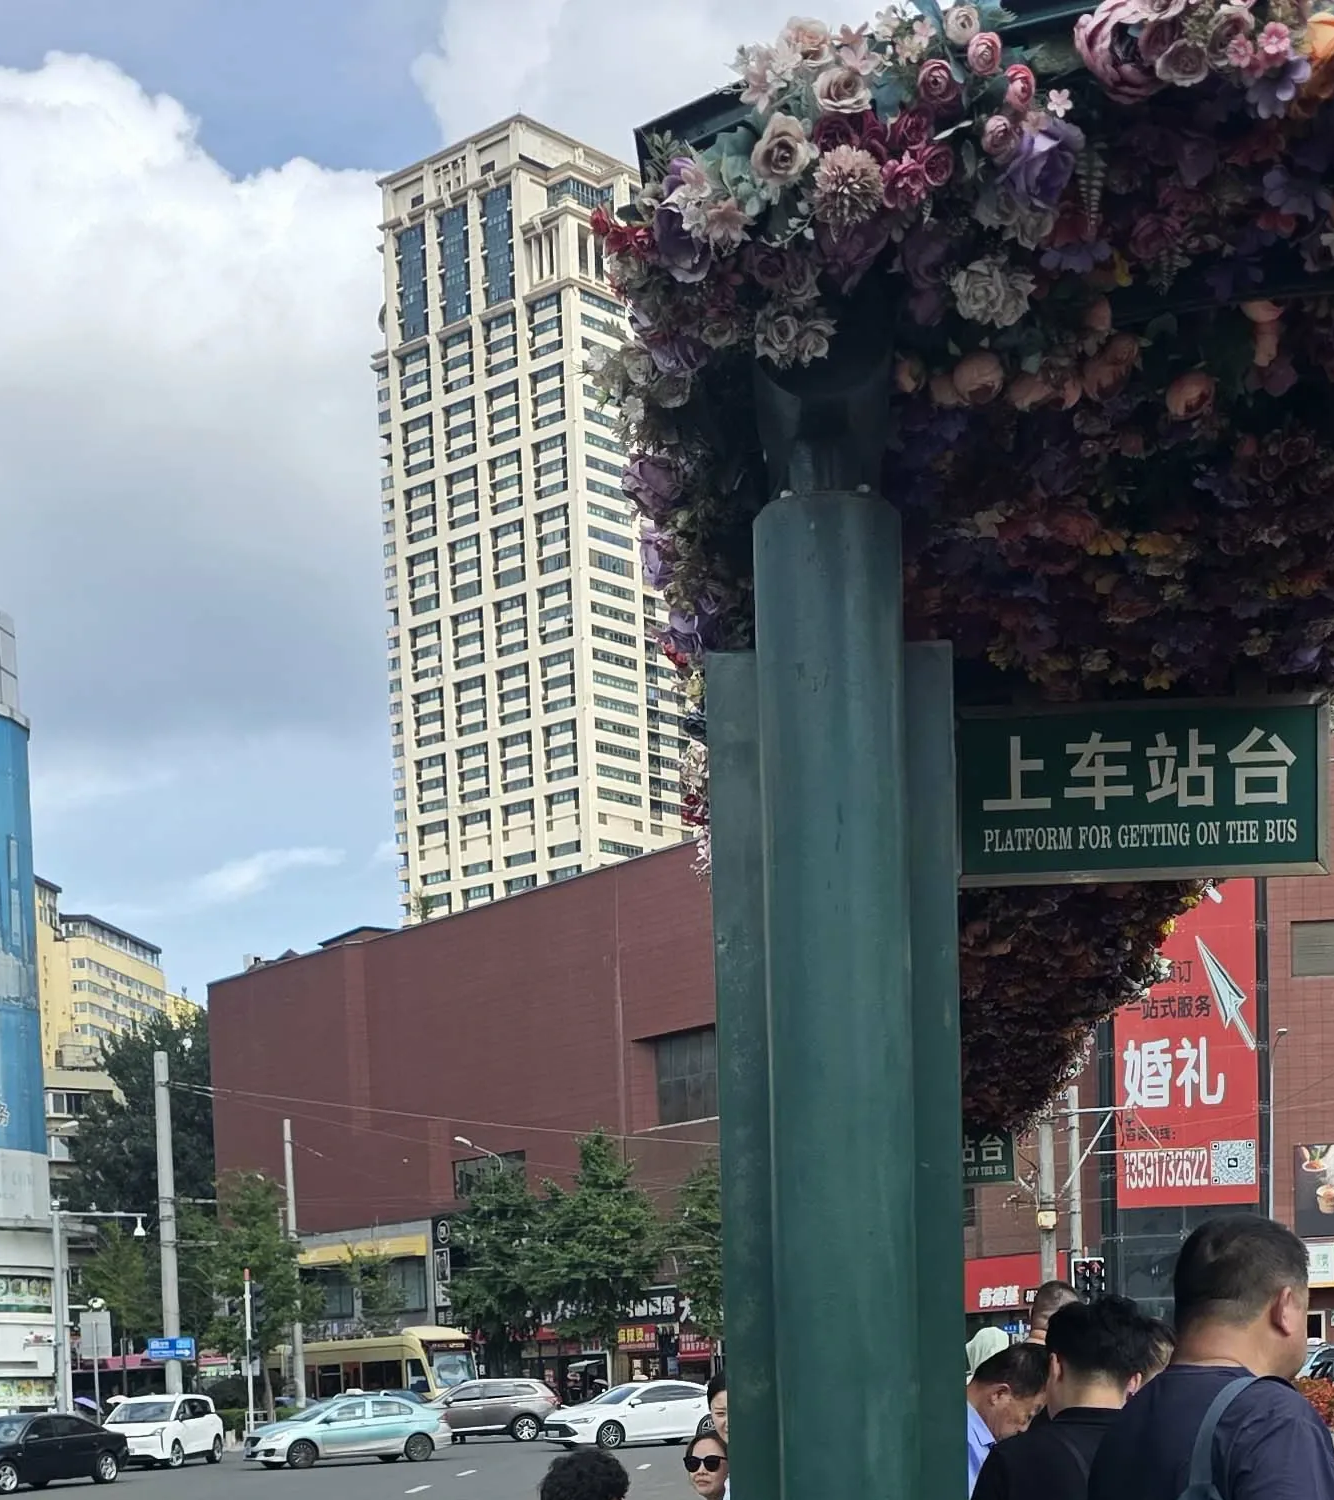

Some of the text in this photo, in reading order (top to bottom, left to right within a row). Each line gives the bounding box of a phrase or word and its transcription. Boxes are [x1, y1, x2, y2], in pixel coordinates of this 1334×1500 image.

[982, 727, 1298, 811] 上车站台
[983, 818, 1298, 853] PLATFORM FOR GETTING ON THE BUS
[1125, 995, 1212, 1020] 一站式服务
[1123, 1036, 1225, 1108] 婚礼
[1123, 1150, 1209, 1190] 13591732622
